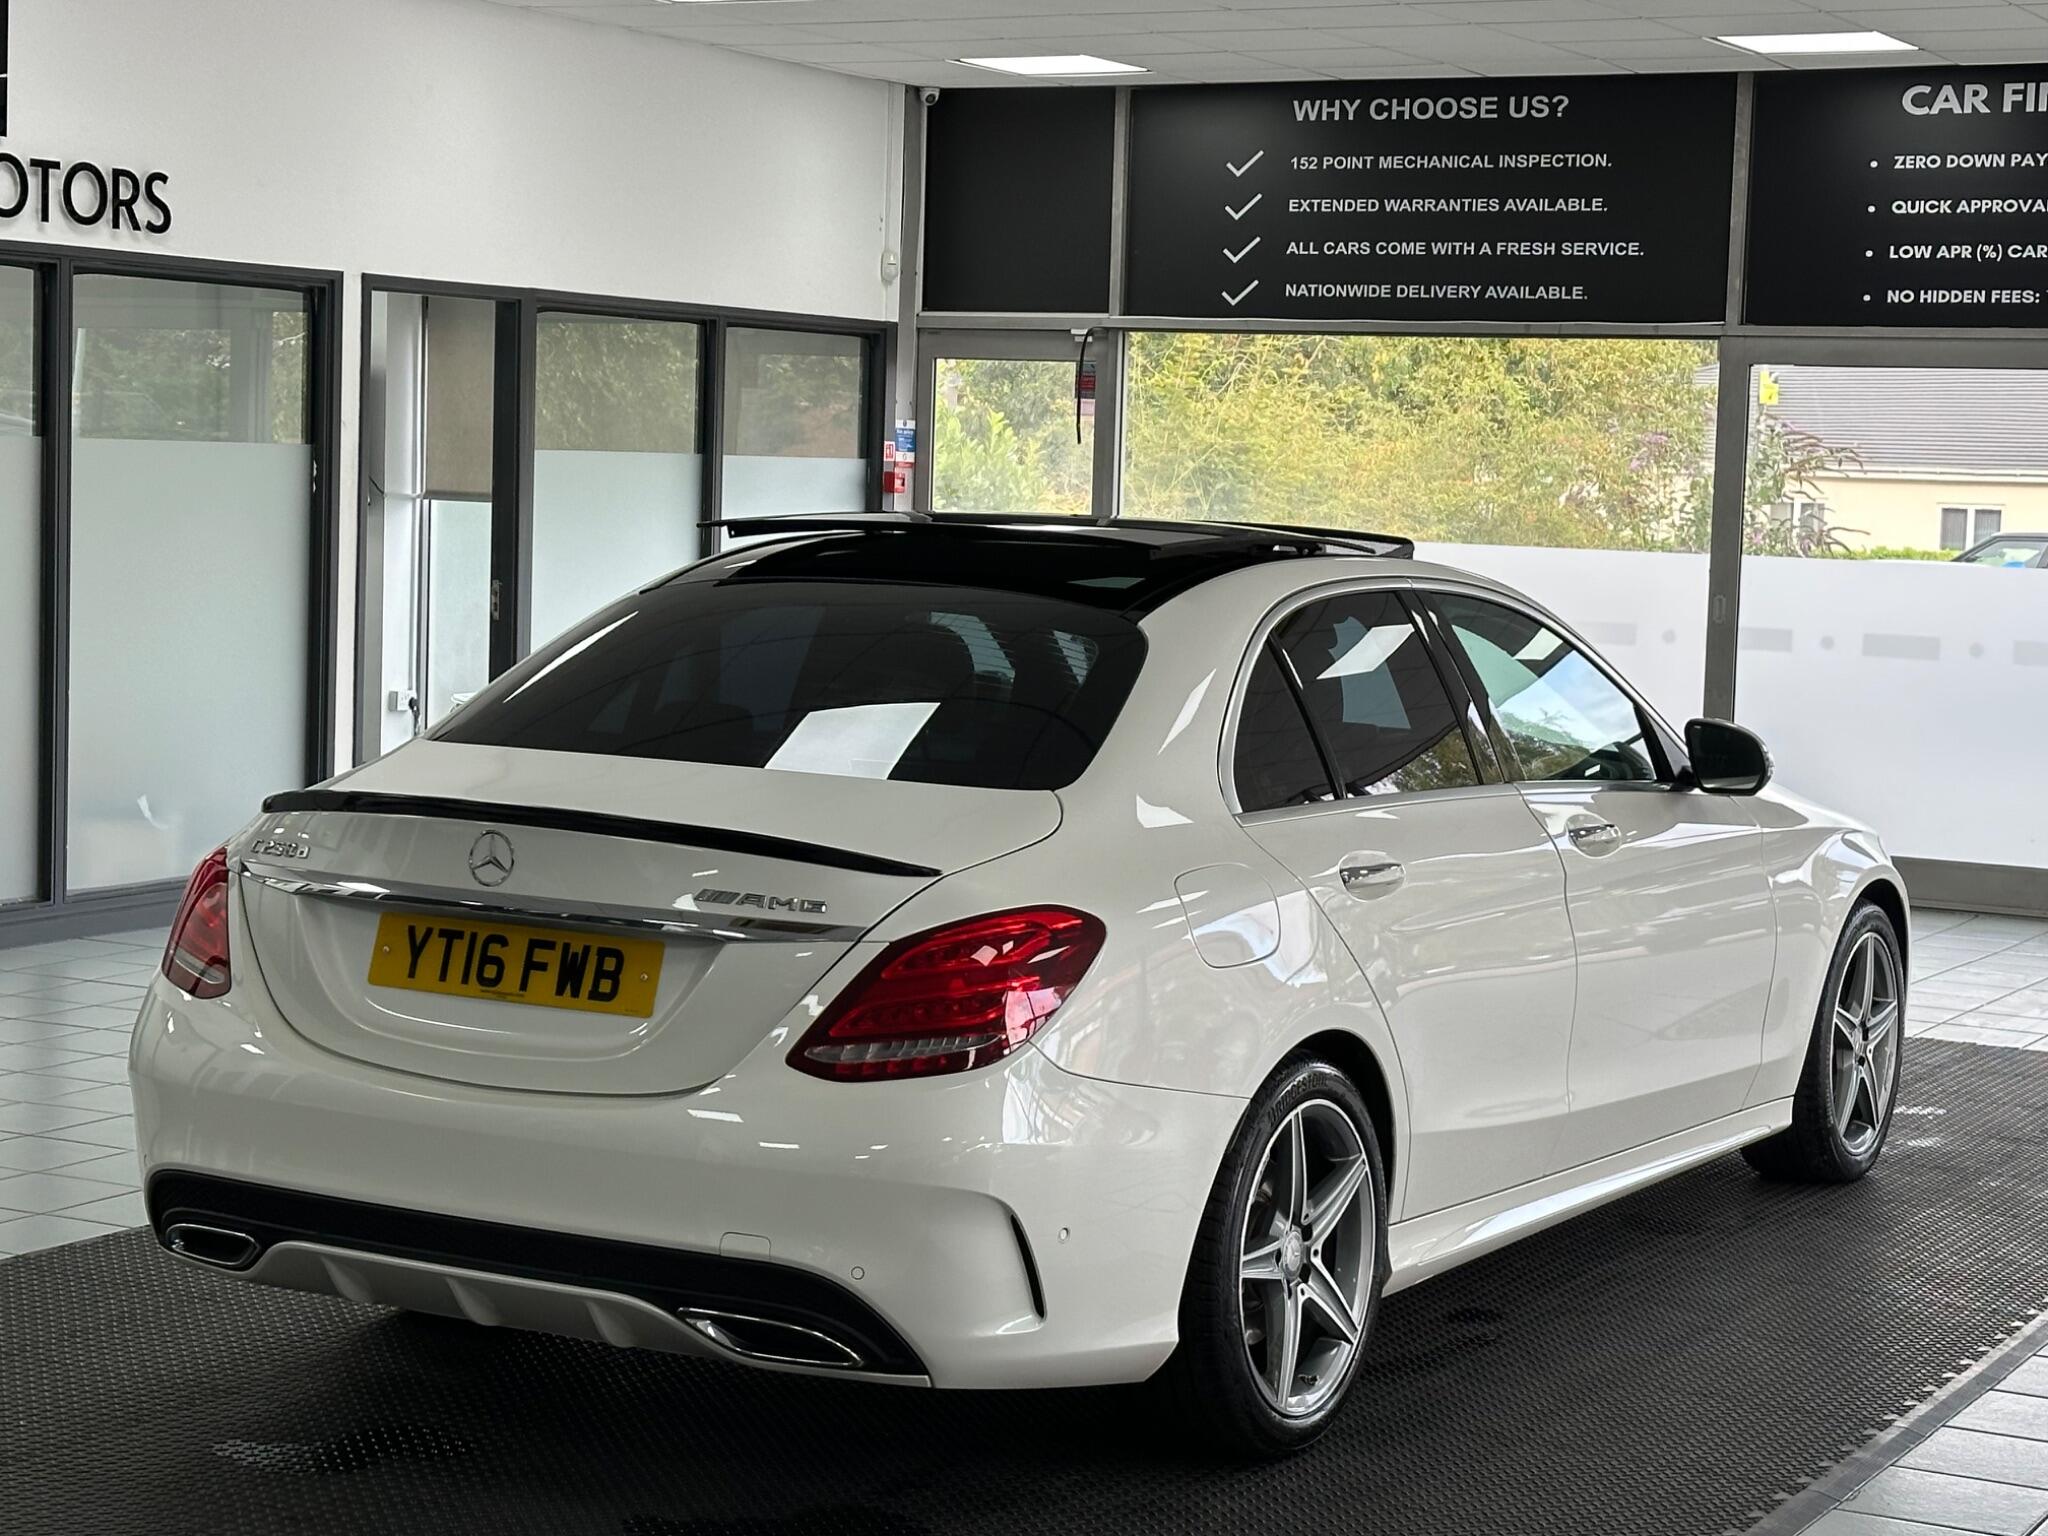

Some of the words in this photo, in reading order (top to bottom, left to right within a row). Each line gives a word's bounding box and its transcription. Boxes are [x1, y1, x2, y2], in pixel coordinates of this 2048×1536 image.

[1901, 83, 1991, 116] CAR
[1293, 99, 1361, 122] WHY
[1369, 96, 1498, 121] CHOOSE
[1509, 95, 1570, 118] US?
[1290, 156, 1318, 170] 152
[1322, 155, 1375, 170] POINT
[1378, 154, 1494, 170] MECHANICAL
[1498, 153, 1612, 168] INSPECTION.
[1893, 154, 1942, 170] ZERO
[1945, 153, 2006, 169] DOWN
[1288, 198, 1380, 213] EXTENDED
[1383, 198, 1500, 213] WARRANTIES
[1503, 197, 1608, 212] AVAILABLE.
[1891, 199, 1952, 215] QUICK
[1285, 241, 1320, 256] ALL
[1323, 241, 1371, 256] CARS
[1375, 241, 1426, 256] COME
[1430, 241, 1475, 256] WITH
[1478, 242, 1492, 256] A
[1496, 242, 1556, 256] FRESH
[1561, 242, 1645, 257] SERVICE.
[1888, 244, 1933, 260] LOW
[1935, 244, 1973, 259] APR
[1976, 243, 2003, 263] (%)
[2007, 244, 2048, 259] CAR
[1285, 283, 1392, 299] NATIONWIDE
[1396, 284, 1482, 299] DELIVERY
[1485, 285, 1589, 300] AVAILABLE.
[1886, 289, 1915, 304] NO
[1919, 289, 1986, 304] HIDDEN
[1990, 289, 2040, 304] FEES:
[735, 892, 828, 914] AMG
[407, 925, 510, 989] YT16
[518, 938, 625, 1003] FWB
